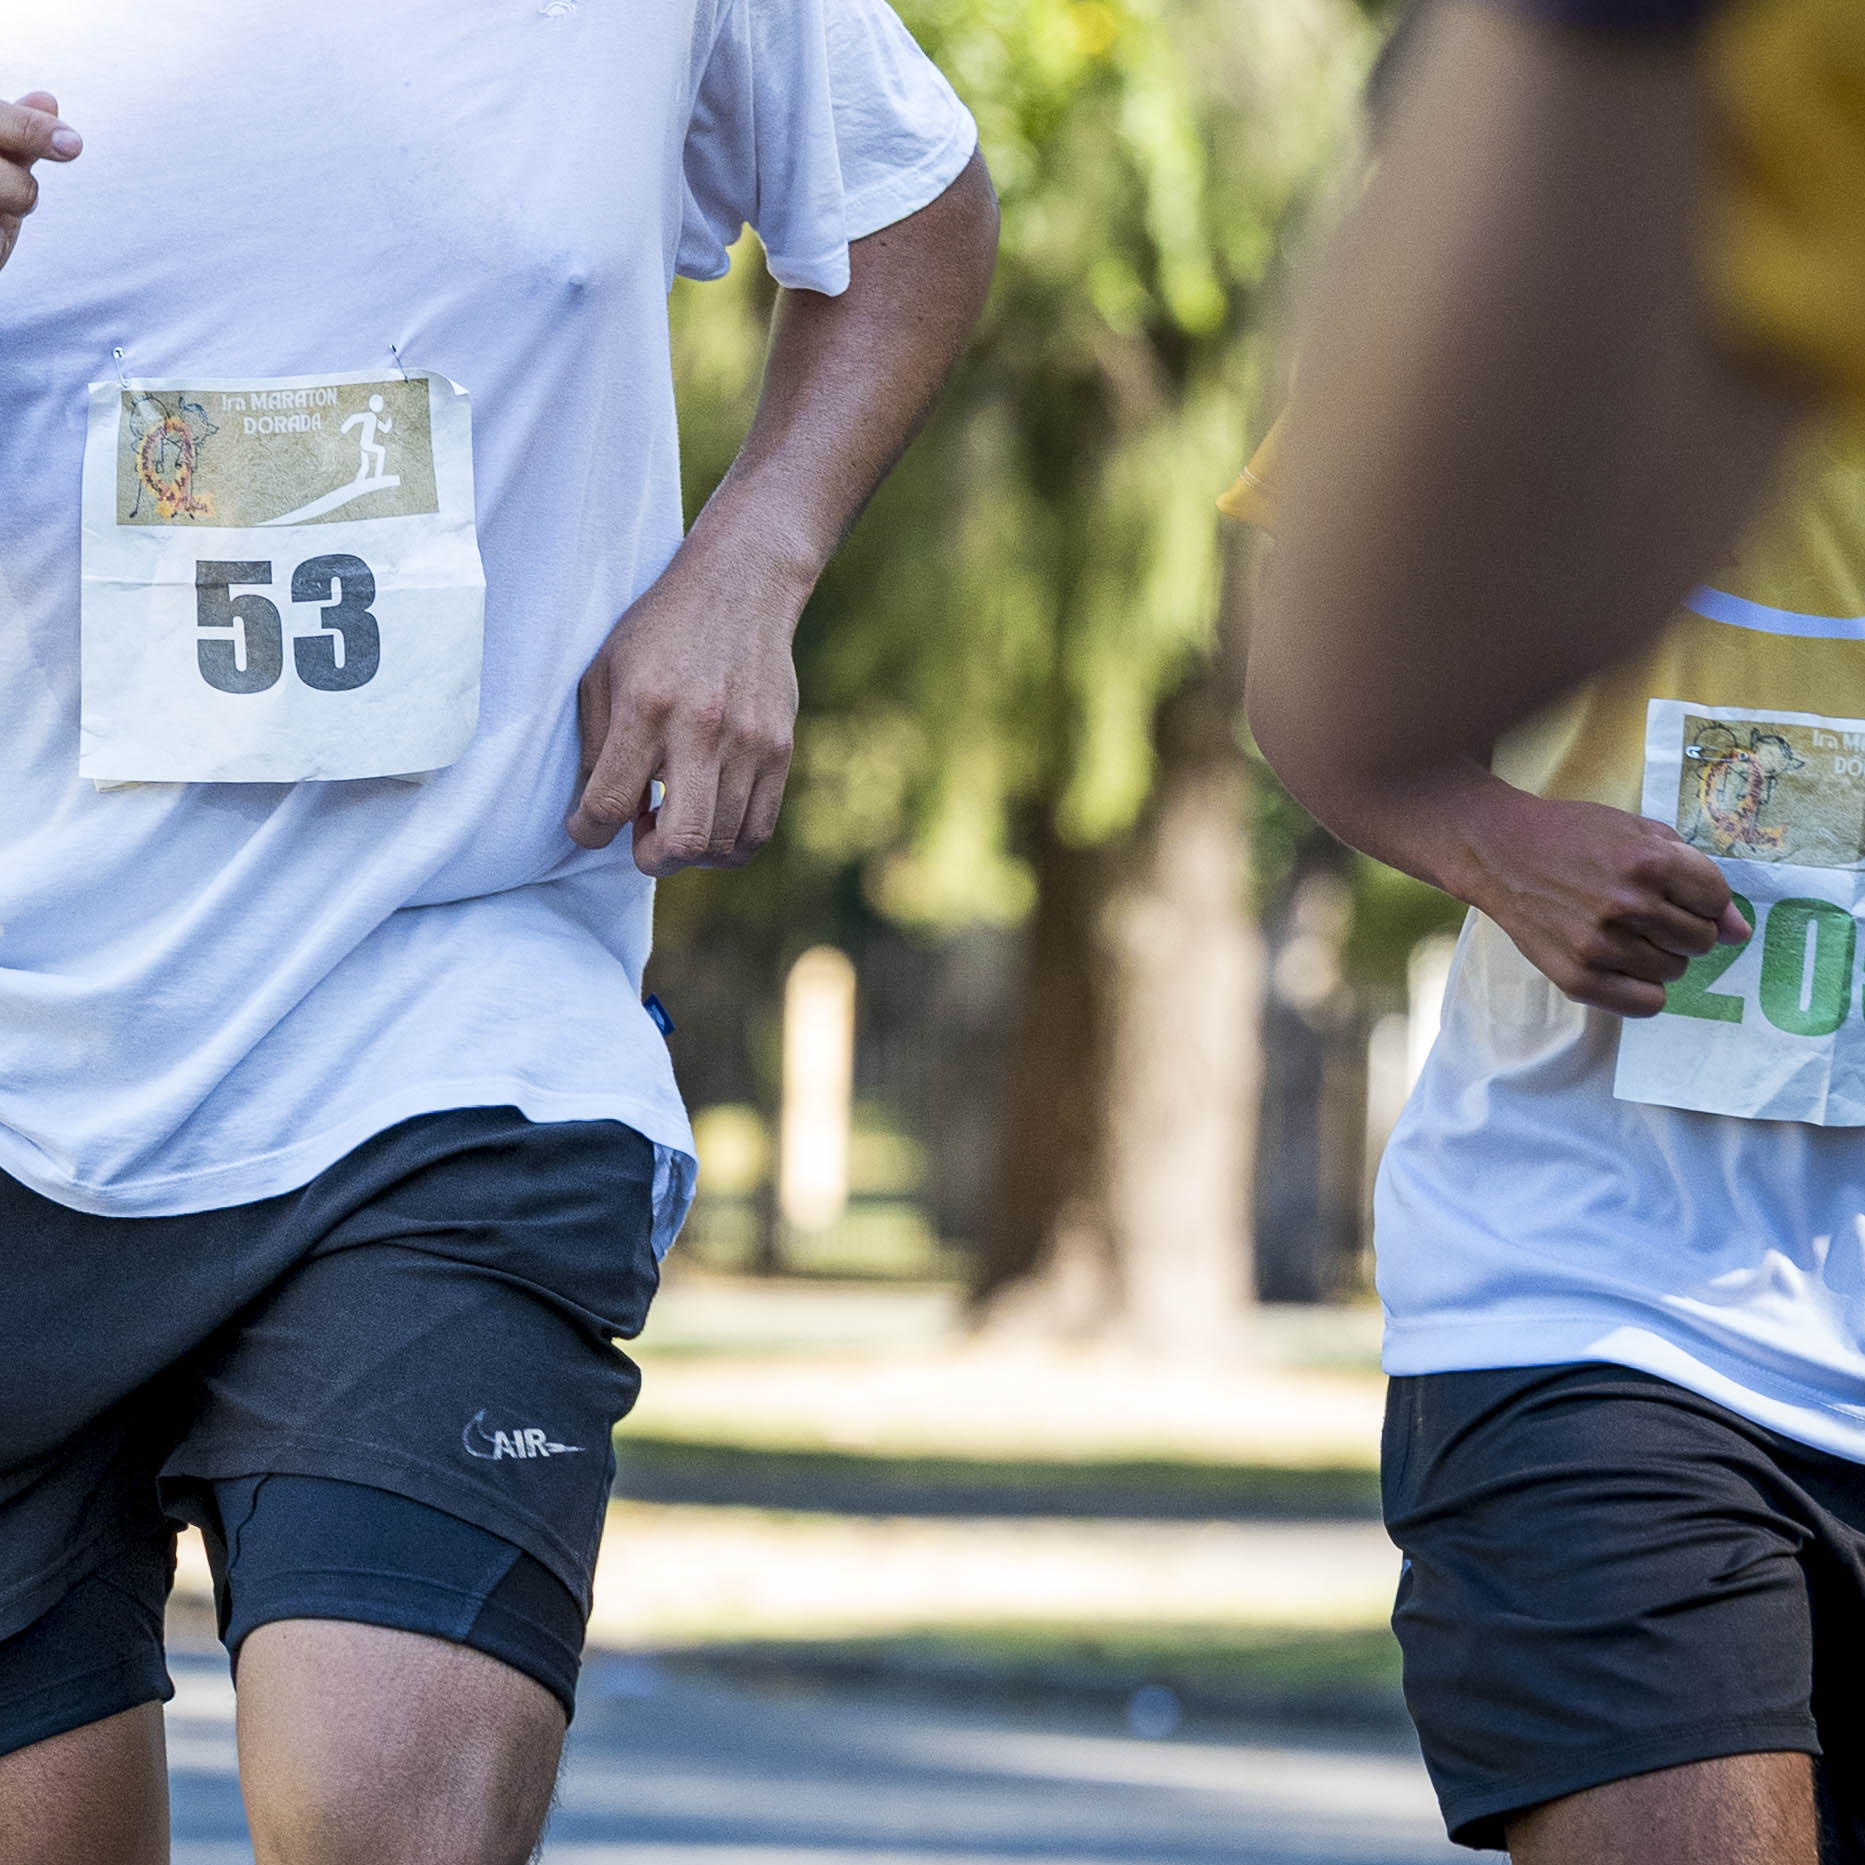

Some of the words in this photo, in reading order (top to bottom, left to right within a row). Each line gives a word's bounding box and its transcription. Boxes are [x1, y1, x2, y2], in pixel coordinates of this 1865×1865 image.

[251, 388, 338, 410] MARATON
[243, 412, 321, 435] DORADA
[196, 554, 380, 694] 53
[493, 1428, 550, 1460] AIR
